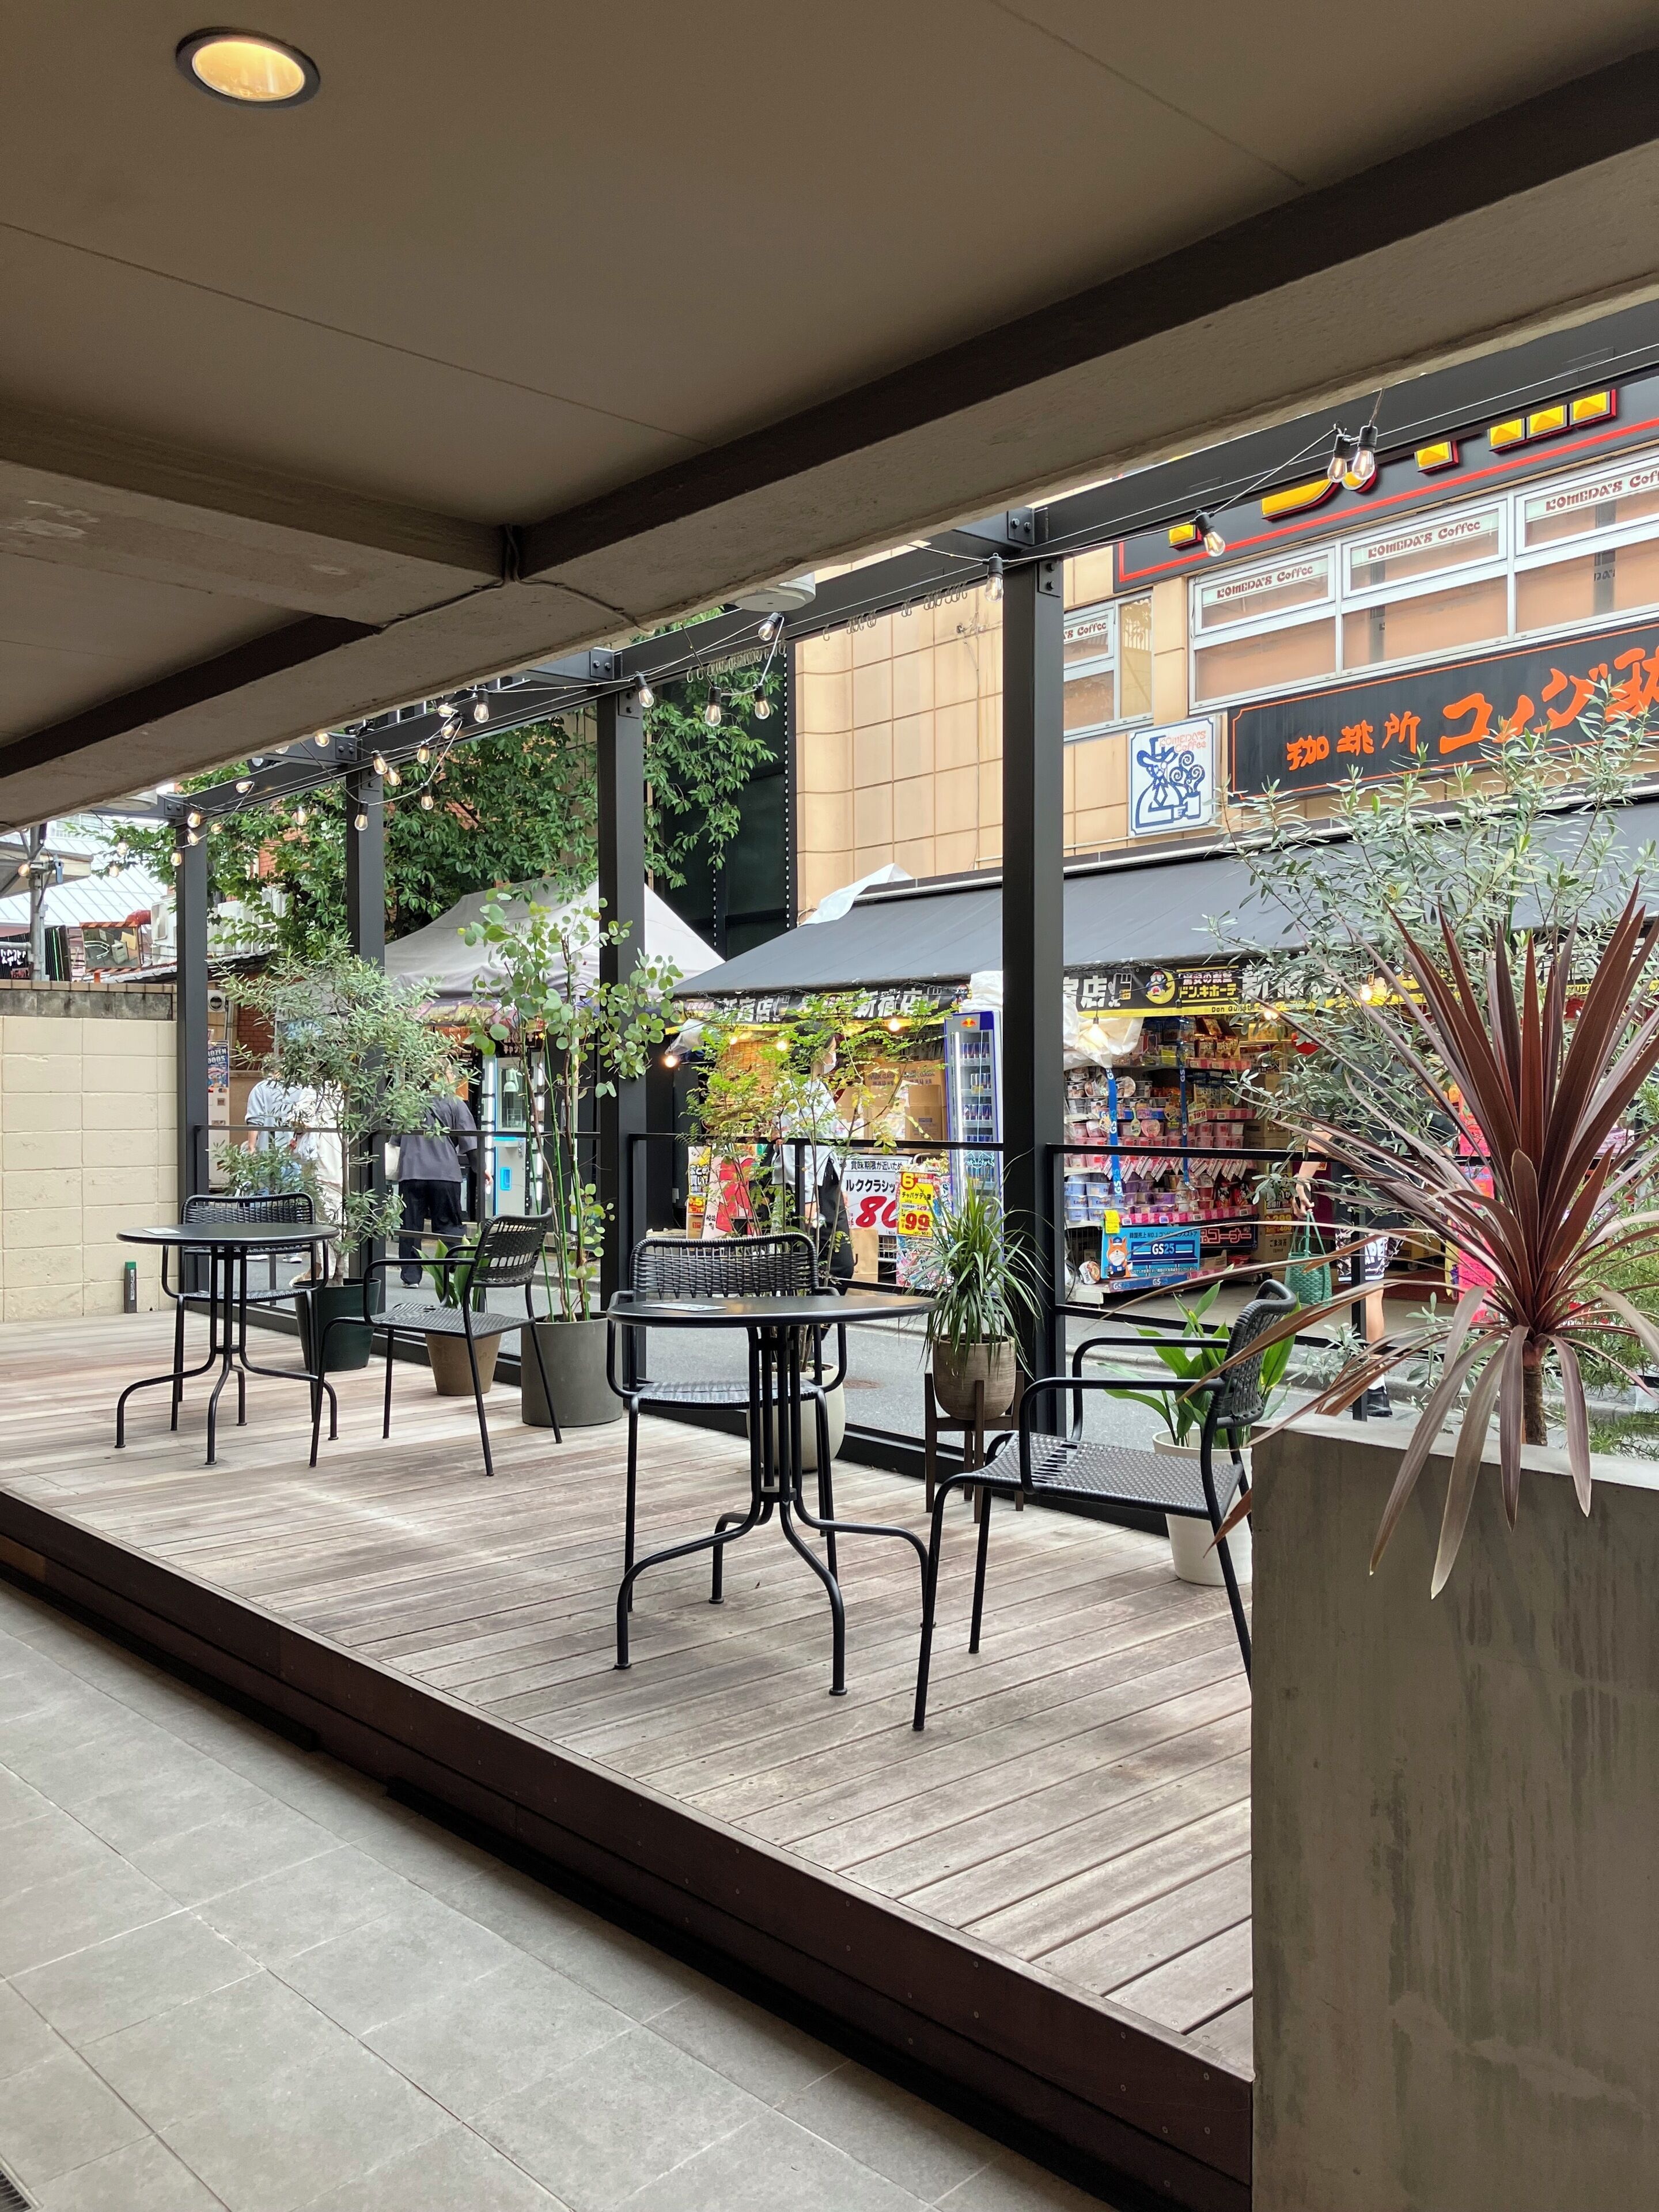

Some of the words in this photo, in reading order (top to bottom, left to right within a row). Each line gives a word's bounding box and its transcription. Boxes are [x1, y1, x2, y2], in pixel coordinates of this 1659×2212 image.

[1546, 480, 1623, 512] KOMEDA'S
[1630, 470, 1659, 488] Cof
[1368, 532, 1433, 559] KOMEDA'S
[1437, 521, 1481, 539] Coffee
[1217, 575, 1272, 599] KOMEDA'S
[1277, 565, 1313, 582] Coffee
[1077, 622, 1107, 636] Coffee
[1159, 730, 1206, 747] KOMEDA'S
[1175, 741, 1206, 752] Coffee
[846, 1179, 896, 1194] ルククラシッ
[905, 1213, 930, 1231] 99
[1152, 1243, 1175, 1255] GS25
